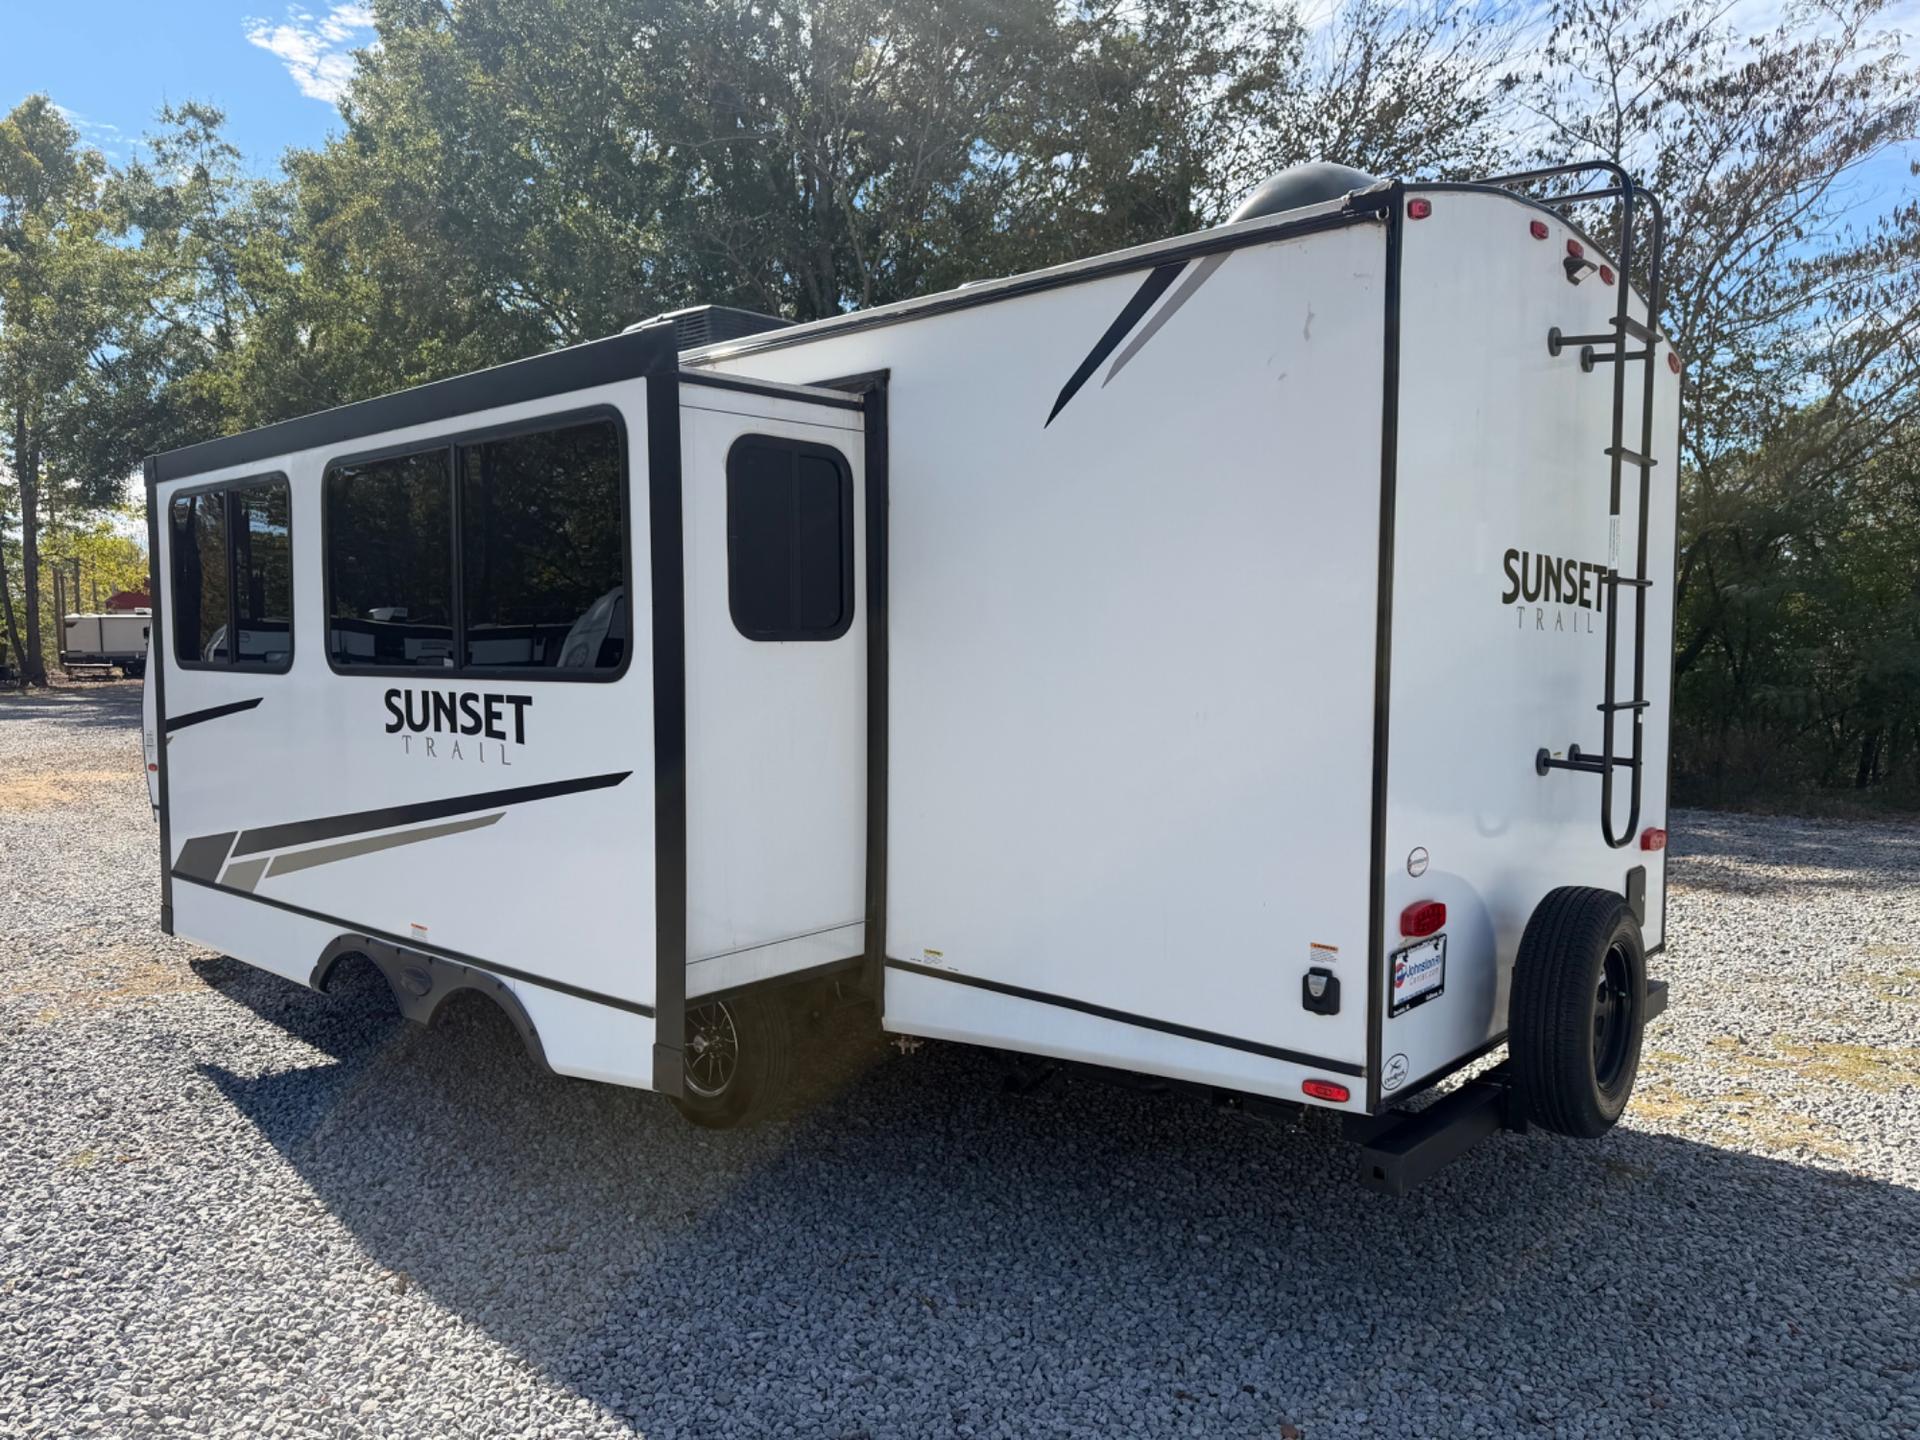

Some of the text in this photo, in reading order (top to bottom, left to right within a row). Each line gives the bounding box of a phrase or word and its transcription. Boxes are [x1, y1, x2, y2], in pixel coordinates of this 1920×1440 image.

[1502, 548, 1608, 613] SUNSET
[1517, 606, 1594, 634] TRAIL
[384, 688, 533, 745] SUNSET
[402, 735, 512, 766] TRAIL
